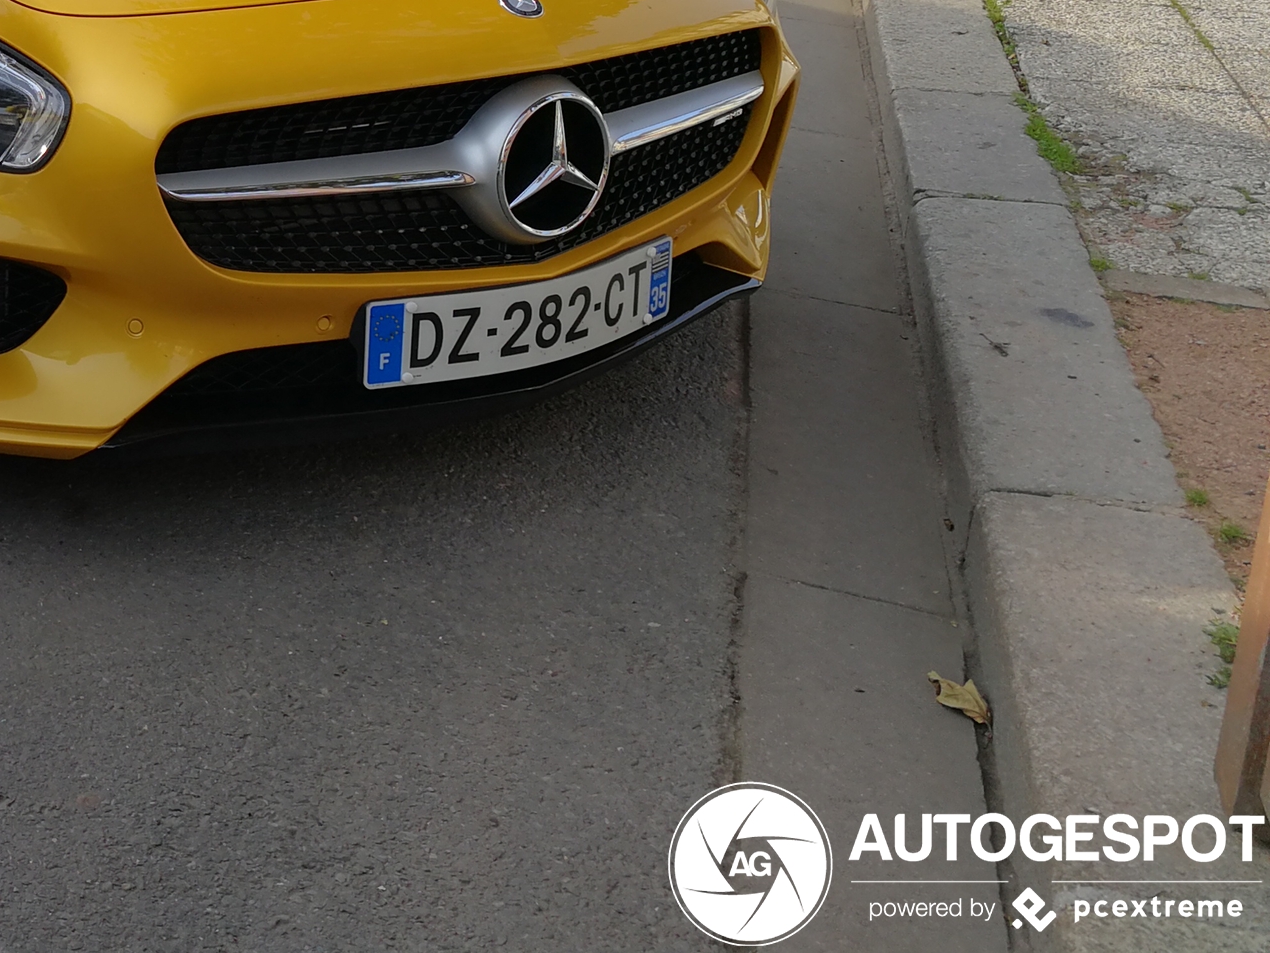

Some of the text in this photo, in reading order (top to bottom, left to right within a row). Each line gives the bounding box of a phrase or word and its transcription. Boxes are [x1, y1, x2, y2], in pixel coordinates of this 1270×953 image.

[649, 281, 668, 314] 35
[409, 260, 648, 369] DZ-282-CT
[379, 352, 390, 371] F
